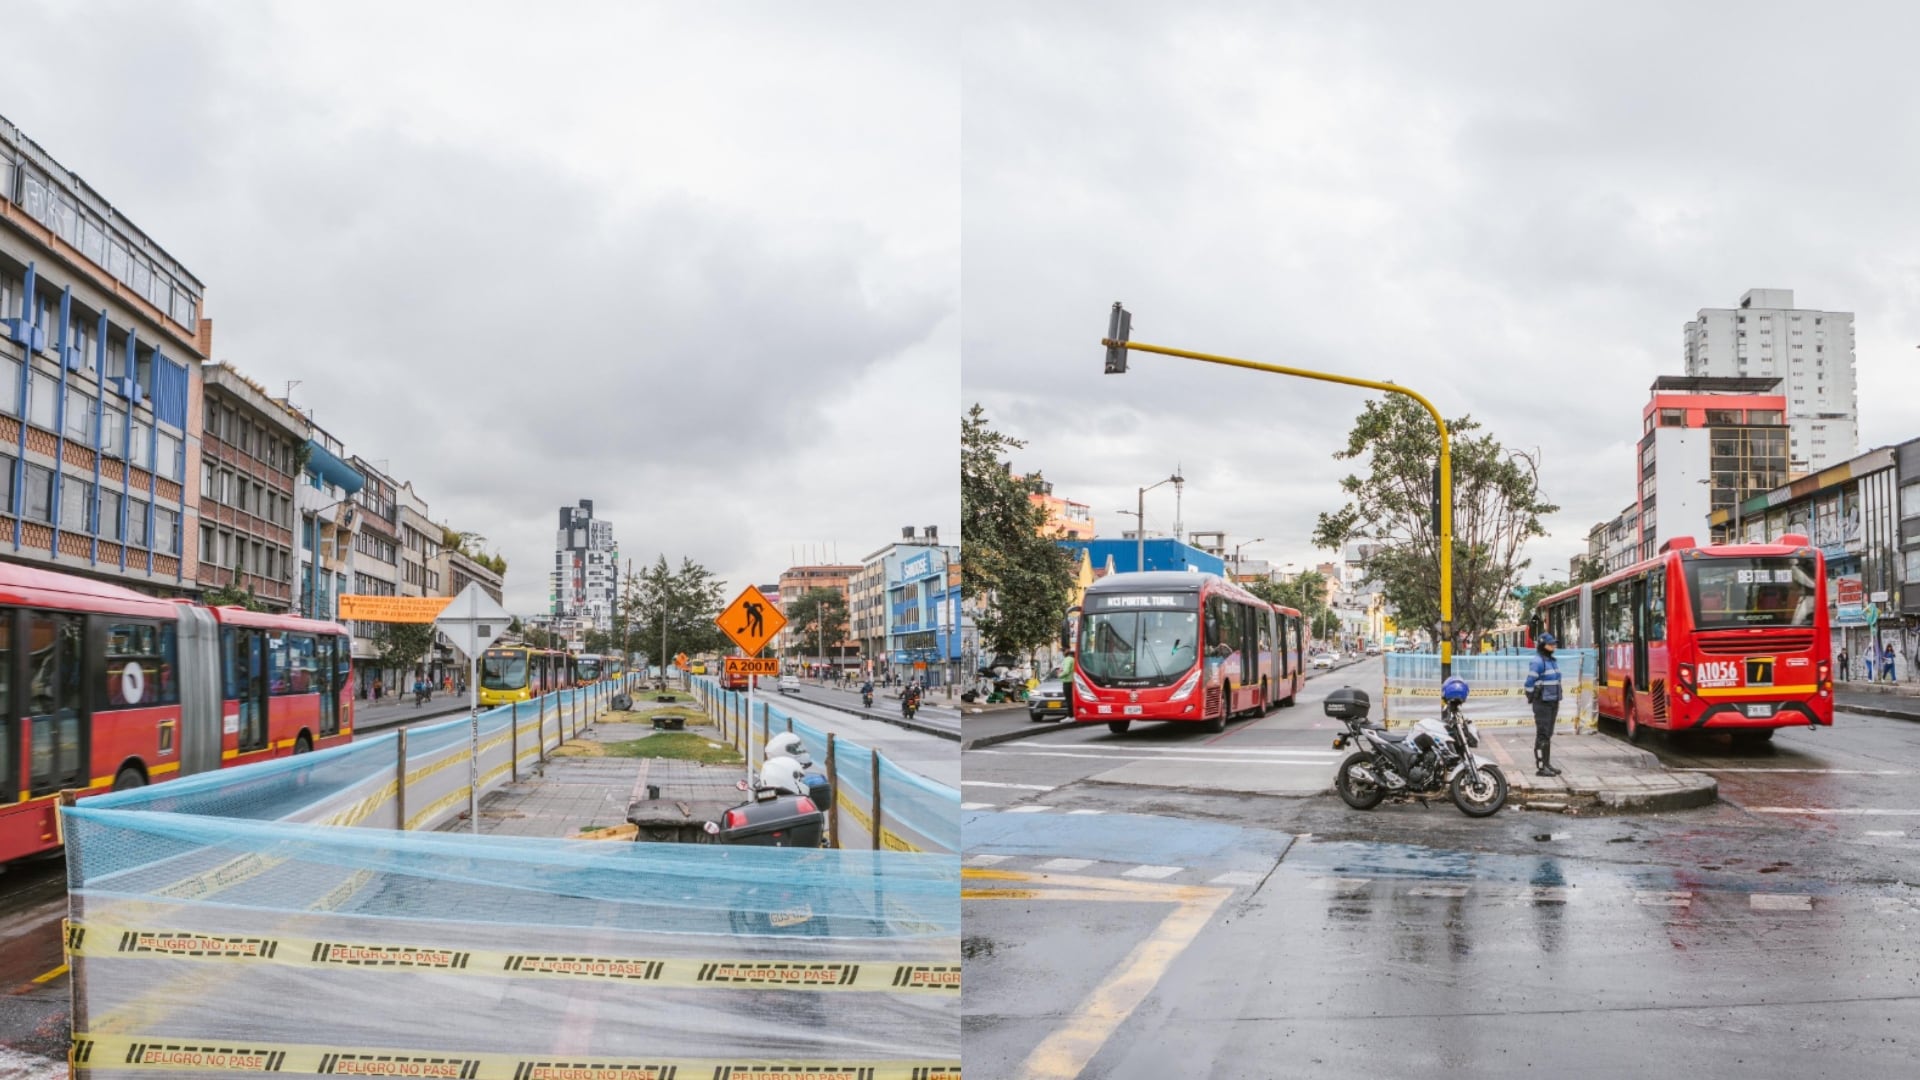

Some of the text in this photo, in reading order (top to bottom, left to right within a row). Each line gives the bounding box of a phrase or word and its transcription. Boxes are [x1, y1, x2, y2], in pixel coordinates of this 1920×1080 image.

[729, 661, 775, 671] A 200 M
[1697, 661, 1738, 681] A1056
[140, 938, 197, 951] PELIGRO
[201, 940, 221, 950] NO
[332, 948, 389, 960] PELIGRO
[416, 953, 449, 963] PASE
[585, 963, 605, 972] NO
[609, 964, 642, 974] PASE
[780, 970, 800, 980] NO
[804, 970, 837, 980] PASE
[145, 1051, 262, 1068] PELIGRO NO PASE
[338, 1061, 457, 1076] PELIGRO NO PASE
[533, 1068, 655, 1080] PELIGRO NO PASE
